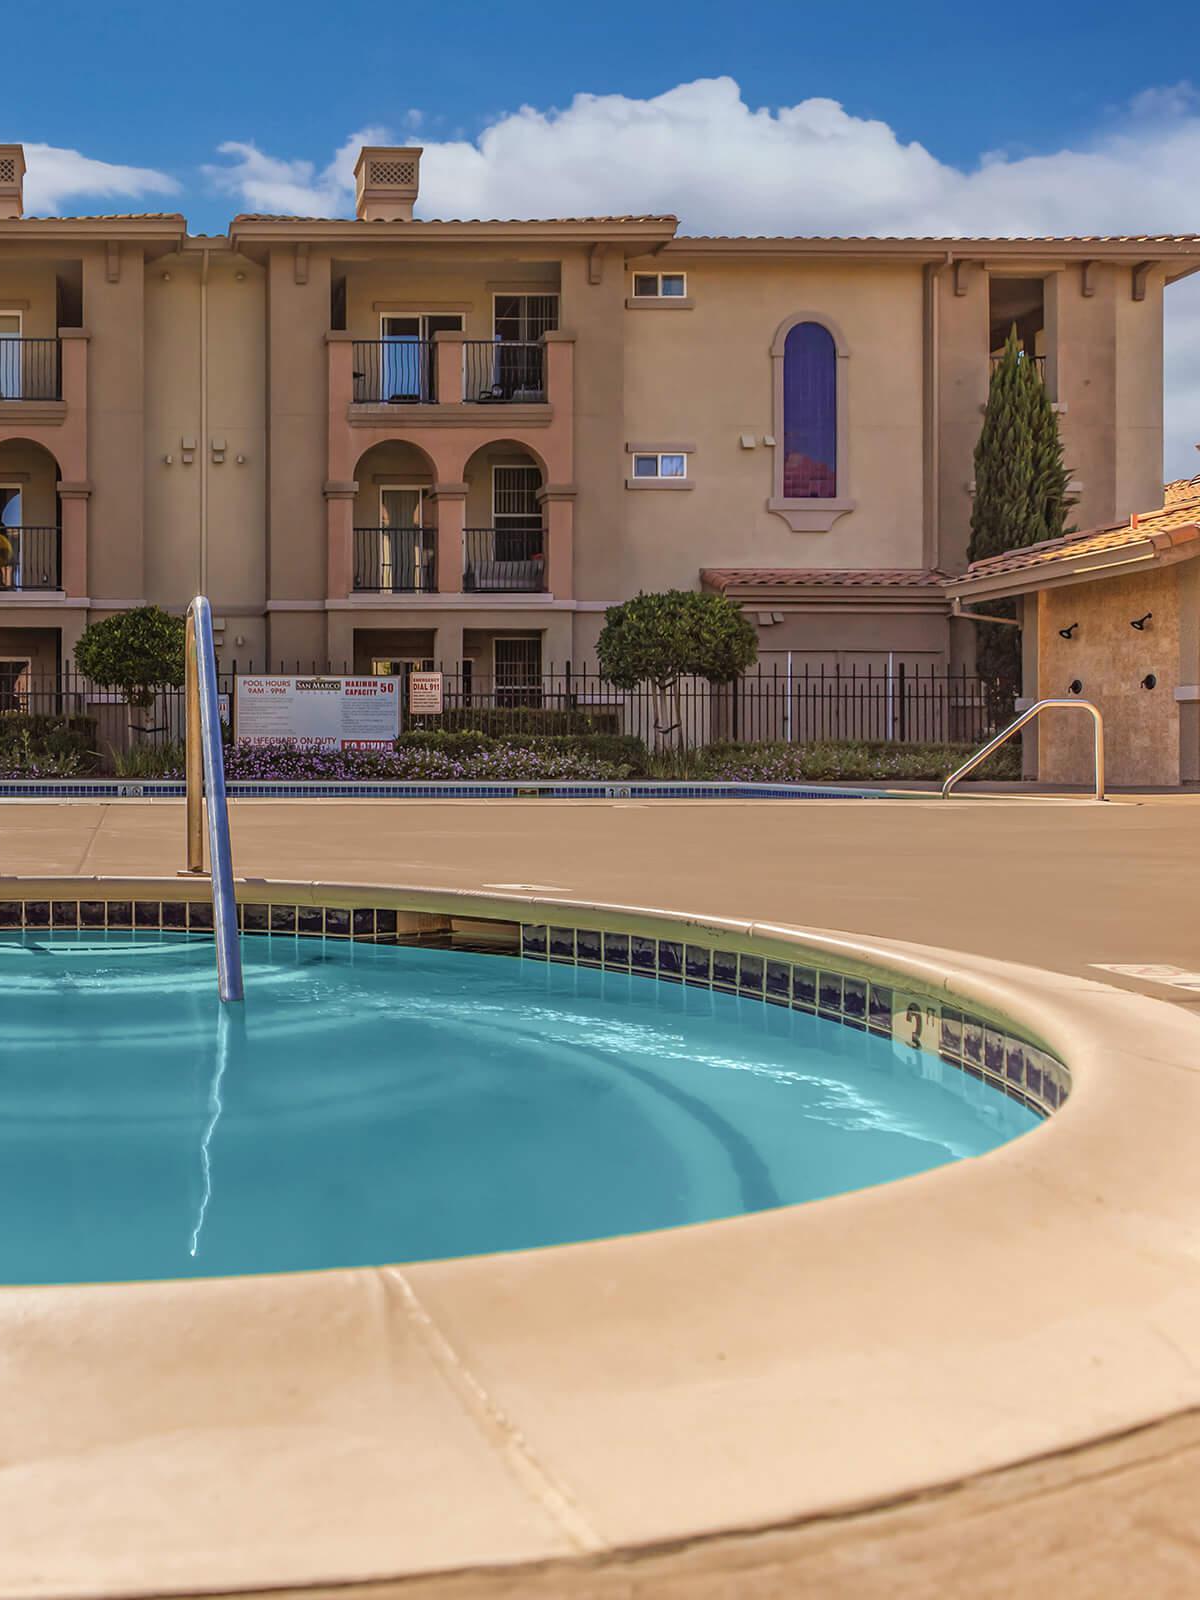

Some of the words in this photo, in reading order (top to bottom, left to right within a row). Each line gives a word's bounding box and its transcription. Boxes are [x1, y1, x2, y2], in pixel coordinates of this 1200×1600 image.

[296, 681, 311, 689] SAN
[312, 681, 340, 689] MARCO
[380, 683, 394, 693] 50
[238, 736, 251, 744] NO
[254, 736, 298, 744] LIFEGUARD
[300, 736, 313, 744] ON
[315, 736, 337, 744] DUTY
[344, 741, 357, 750] NO
[360, 741, 393, 750] DIVING
